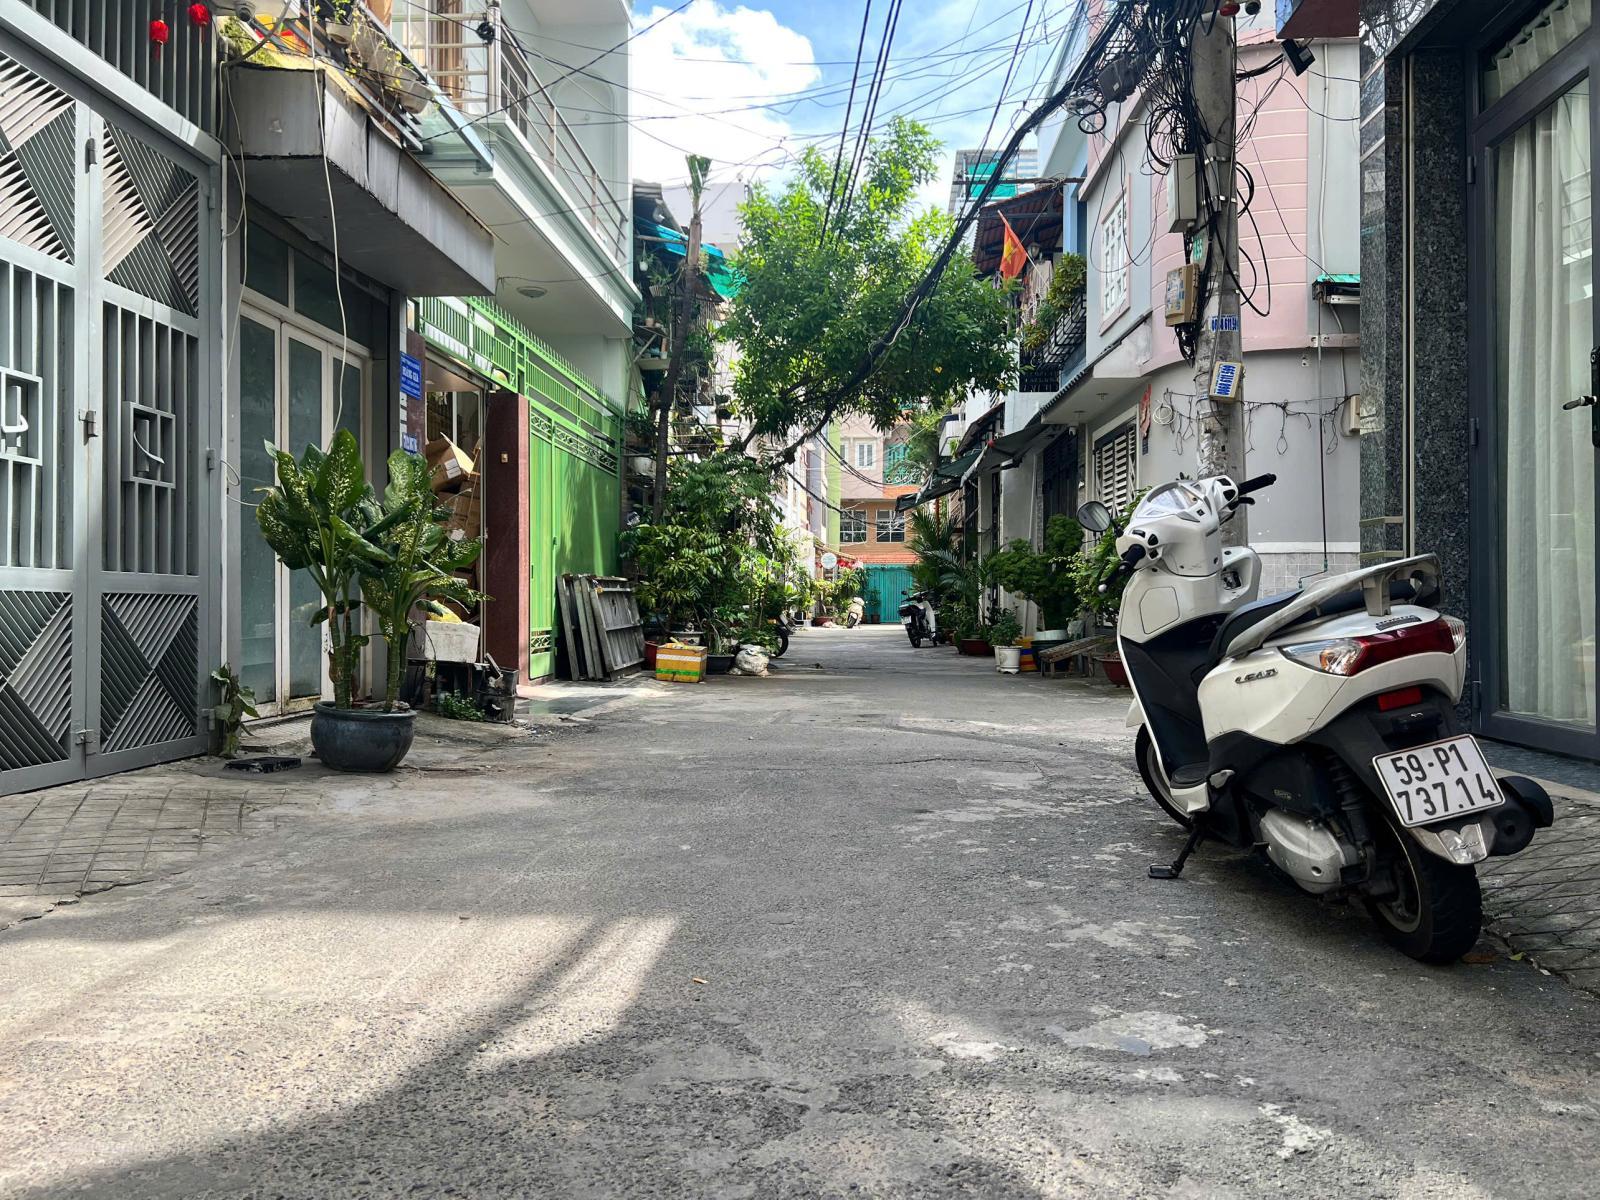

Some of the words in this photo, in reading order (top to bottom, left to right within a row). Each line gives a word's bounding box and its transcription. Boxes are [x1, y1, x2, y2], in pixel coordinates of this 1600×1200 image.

[1235, 668, 1278, 684] LEAD
[1390, 744, 1468, 785] 59-P1
[1396, 773, 1495, 821] 737.14
